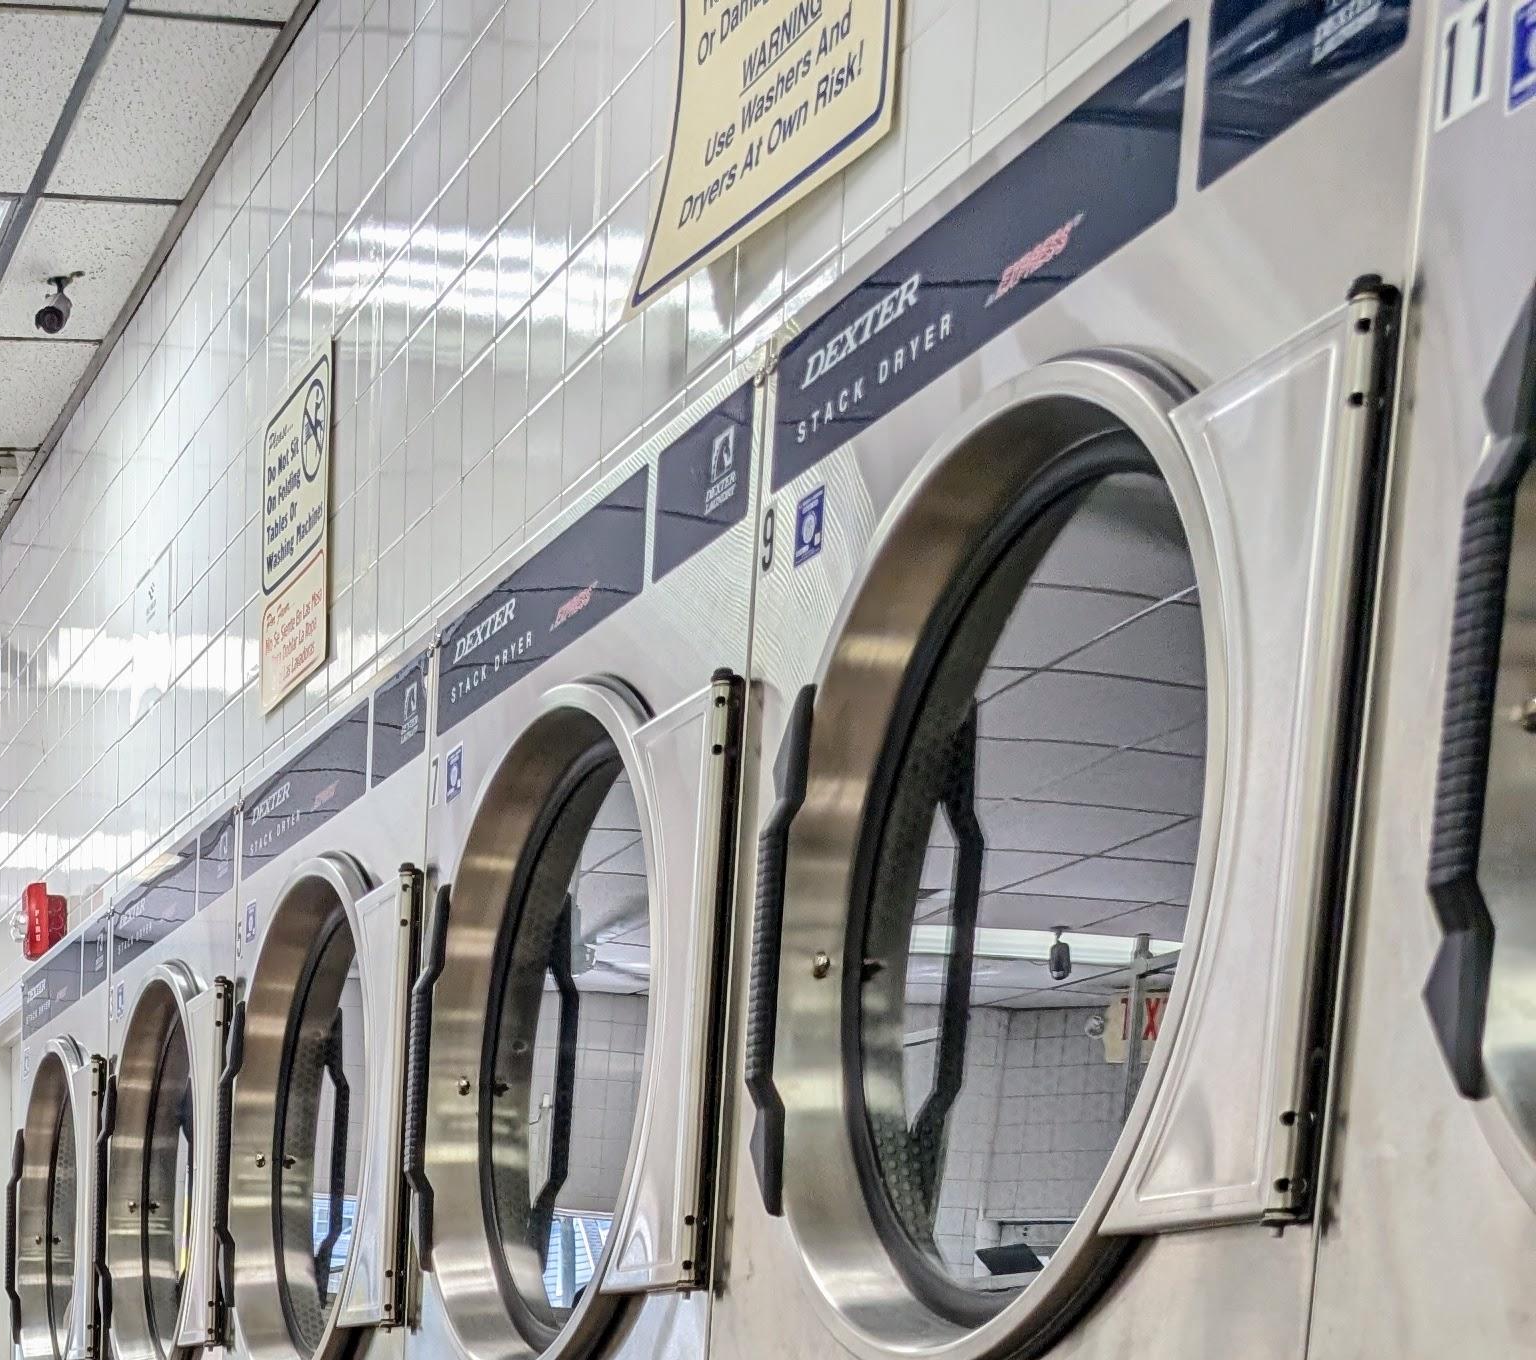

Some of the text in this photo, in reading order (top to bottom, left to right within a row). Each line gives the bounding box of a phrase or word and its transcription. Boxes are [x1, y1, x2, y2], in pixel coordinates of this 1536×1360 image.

[698, 28, 716, 66] Or
[742, 0, 823, 89] WARNING
[704, 0, 852, 167] Use Washers And
[678, 39, 865, 230] Dryers At Own Risk!
[800, 273, 922, 390] DEXTER
[796, 313, 953, 443] STACK DRYER
[267, 465, 276, 487] Do
[278, 449, 289, 475] Not
[267, 468, 301, 515] On Folding
[266, 536, 294, 574] Washing
[267, 501, 297, 546] Tables Or
[762, 507, 775, 572] 9
[453, 597, 516, 664] DEXTER
[450, 631, 533, 704] STACK DRYER
[251, 781, 291, 826] DEXTER
